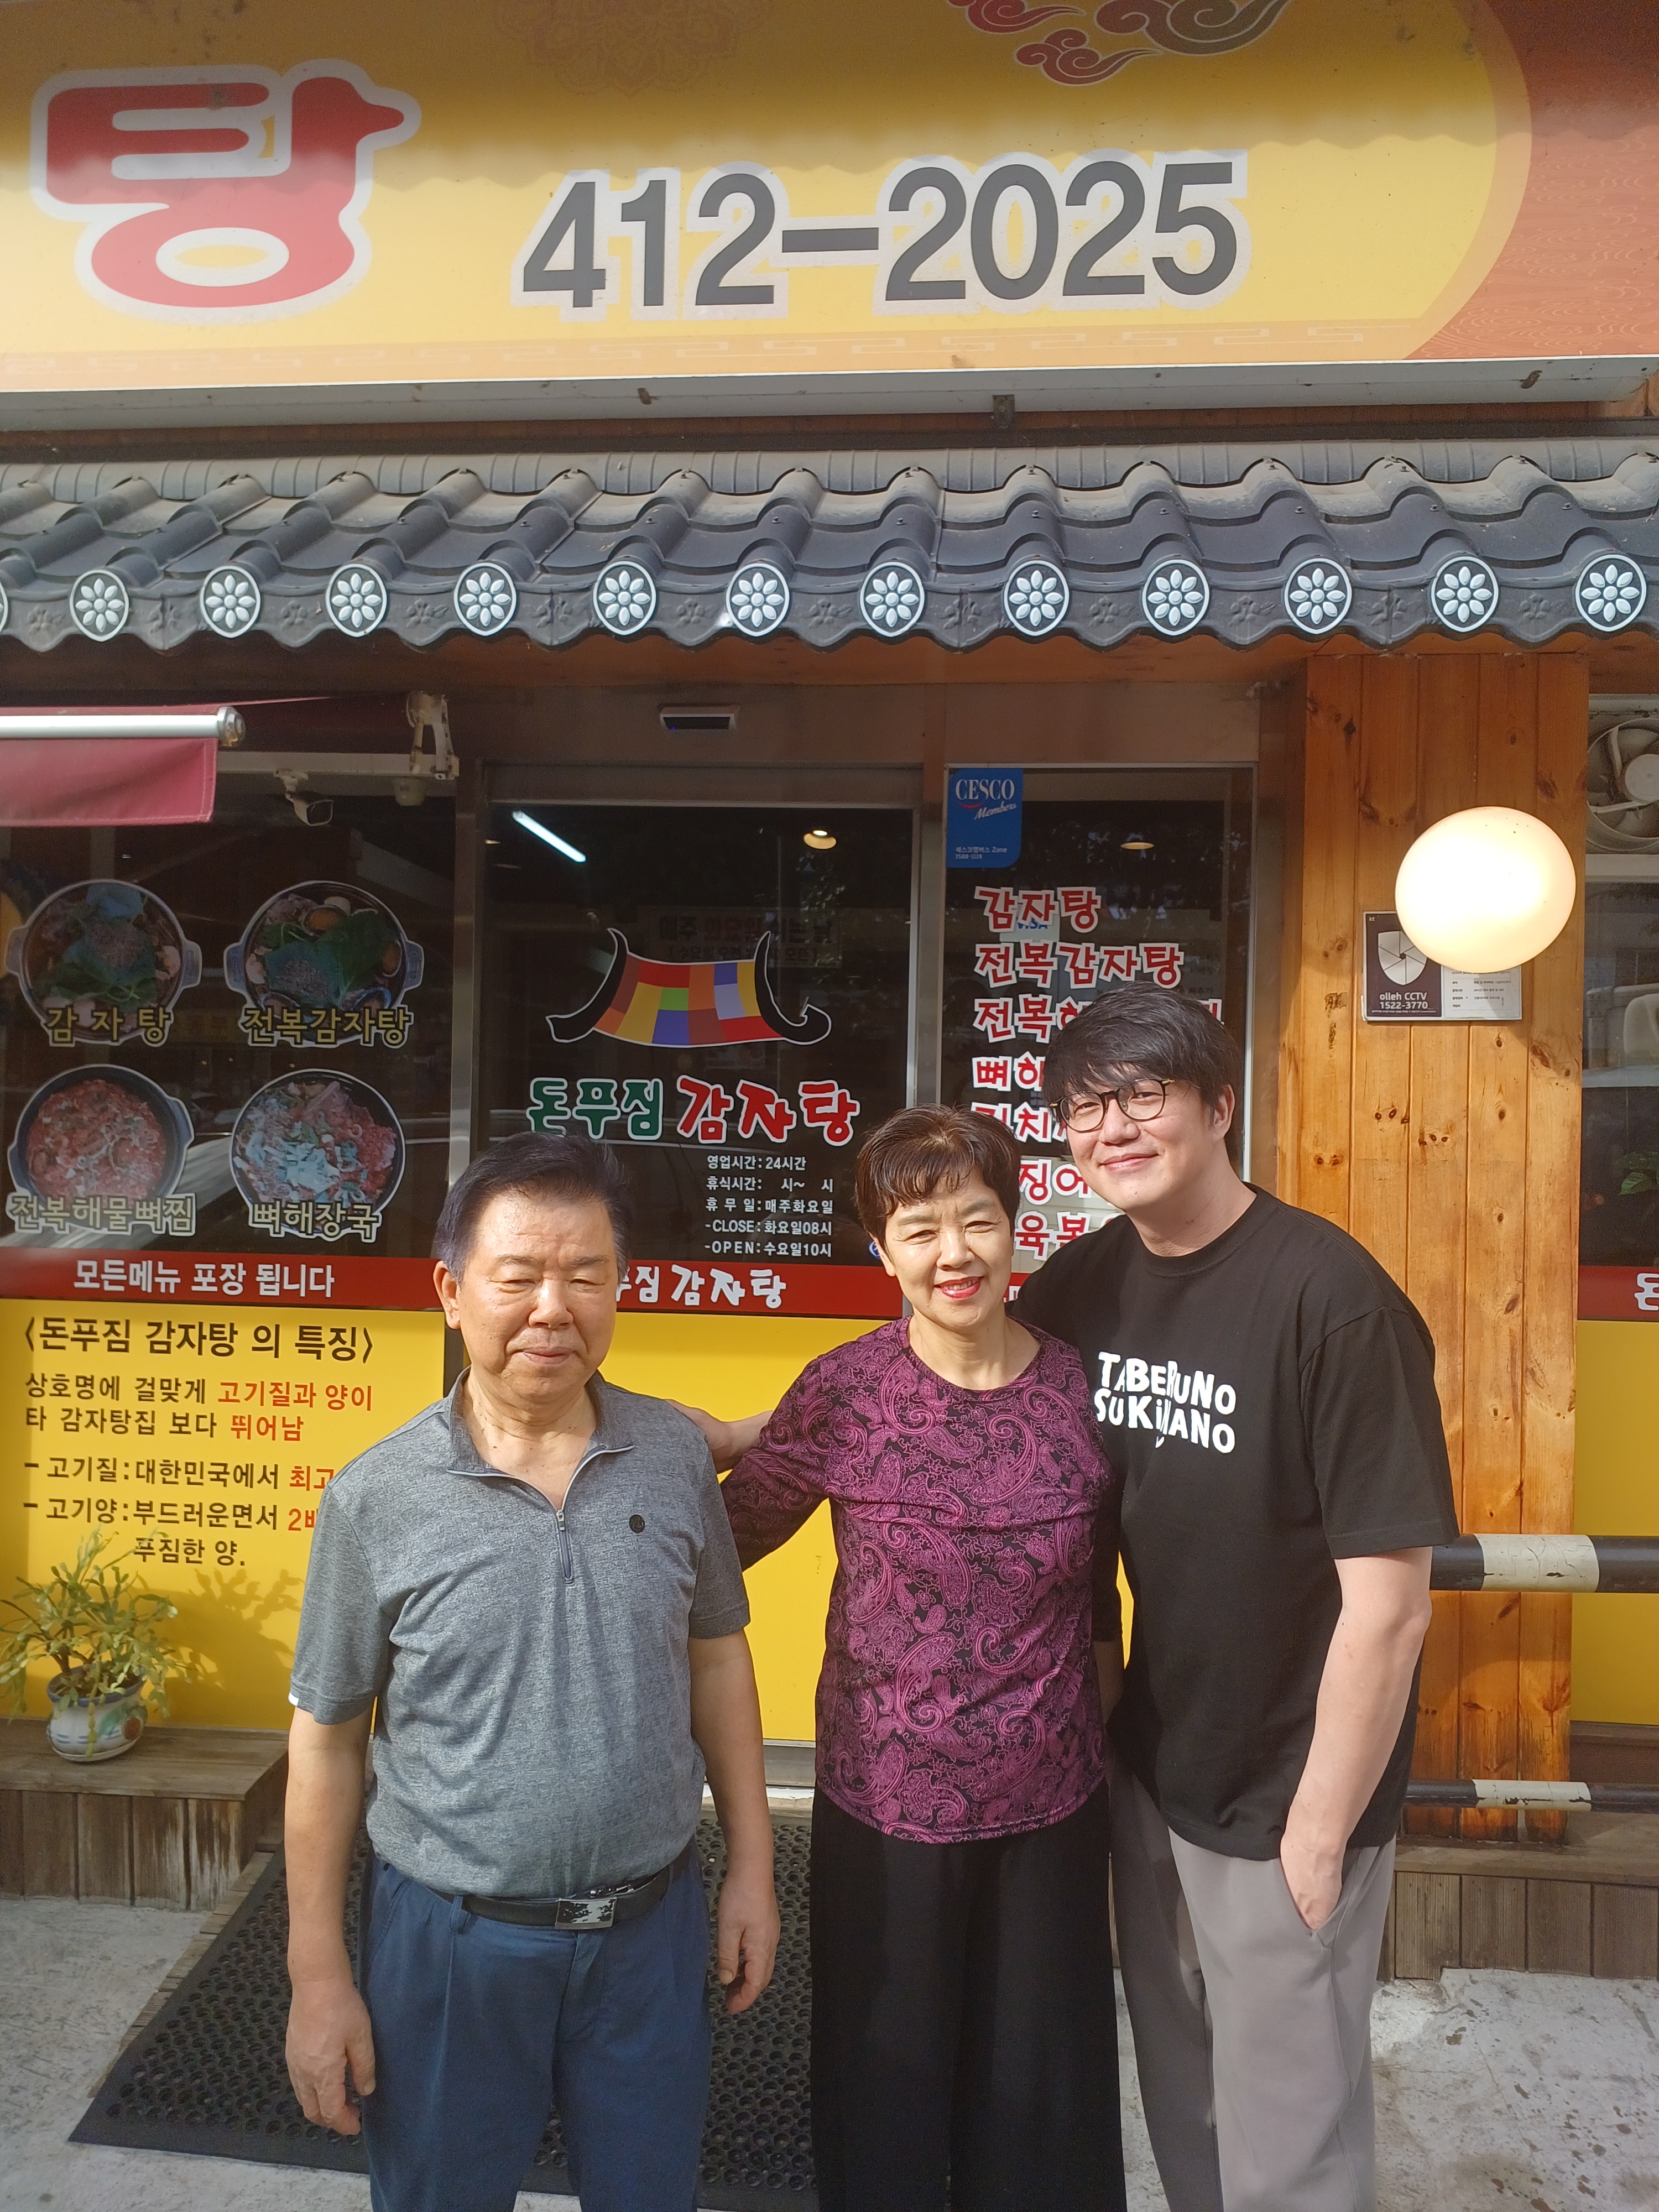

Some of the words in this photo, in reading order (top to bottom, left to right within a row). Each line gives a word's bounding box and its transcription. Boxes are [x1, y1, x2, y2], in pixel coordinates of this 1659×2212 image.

[36, 64, 416, 313] 탕
[520, 158, 1241, 310] 412-2025
[955, 779, 1015, 800] CESCO
[974, 801, 1018, 820] Members
[975, 887, 1100, 932] 감자탕
[975, 941, 1183, 988] 전복감자탕
[1379, 992, 1402, 1000] olleh
[1405, 992, 1428, 1000] CCTV
[1380, 1001, 1428, 1010] 1522-3770
[243, 1006, 411, 1045] 전복감자탕
[676, 1074, 861, 1147] 감자탕
[706, 1176, 763, 1191] 휴식시간:
[821, 1178, 834, 1193] 시
[9, 1194, 195, 1234] 전복해물뼈찜
[253, 1200, 380, 1239] 뼈해장국
[74, 1259, 182, 1295] 모든메뉴
[190, 1263, 247, 1296] 포장
[255, 1264, 335, 1298] 됩니다
[671, 1264, 786, 1309] 감자탕
[145, 1319, 238, 1358] 감자탕
[251, 1323, 281, 1359] 의
[25, 1371, 121, 1401] 상호명에
[134, 1376, 207, 1405] 걸맞게
[218, 1380, 317, 1409] 고기질과
[325, 1383, 374, 1411] 양이
[25, 1406, 48, 1432] 타
[60, 1406, 157, 1436] 감자탕집
[170, 1412, 217, 1438] 보다
[230, 1414, 304, 1442] 뛰어남
[134, 1536, 205, 1564] 푸짐한
[215, 1538, 246, 1566] 양.
